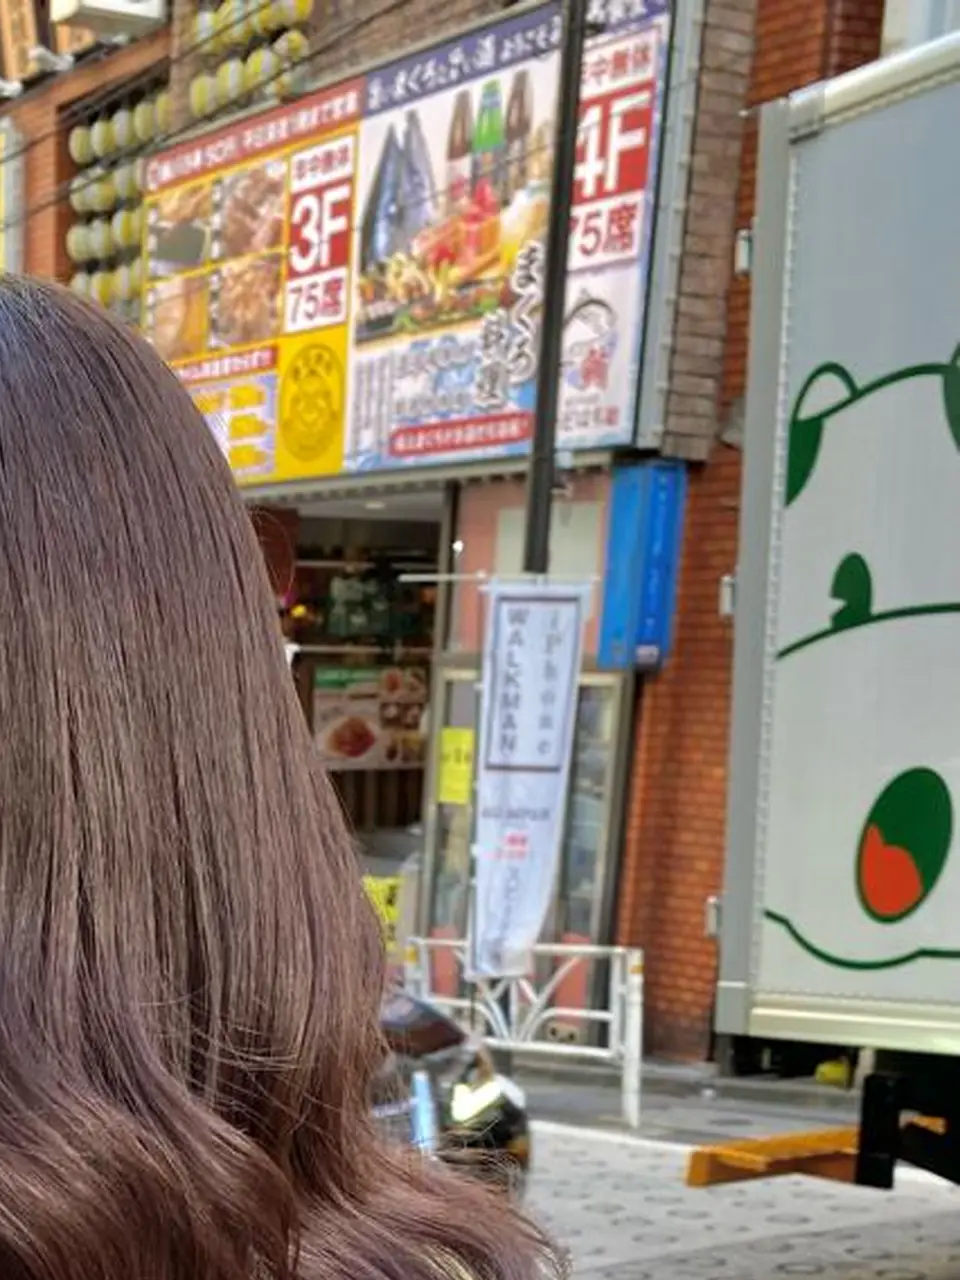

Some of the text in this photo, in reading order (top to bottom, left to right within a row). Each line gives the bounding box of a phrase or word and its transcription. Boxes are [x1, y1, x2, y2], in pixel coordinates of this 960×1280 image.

[581, 42, 651, 86] 中無休
[574, 91, 652, 198] 4F
[290, 183, 351, 273] 3F
[288, 276, 345, 325] 75席
[500, 607, 531, 754] WALKMAN
